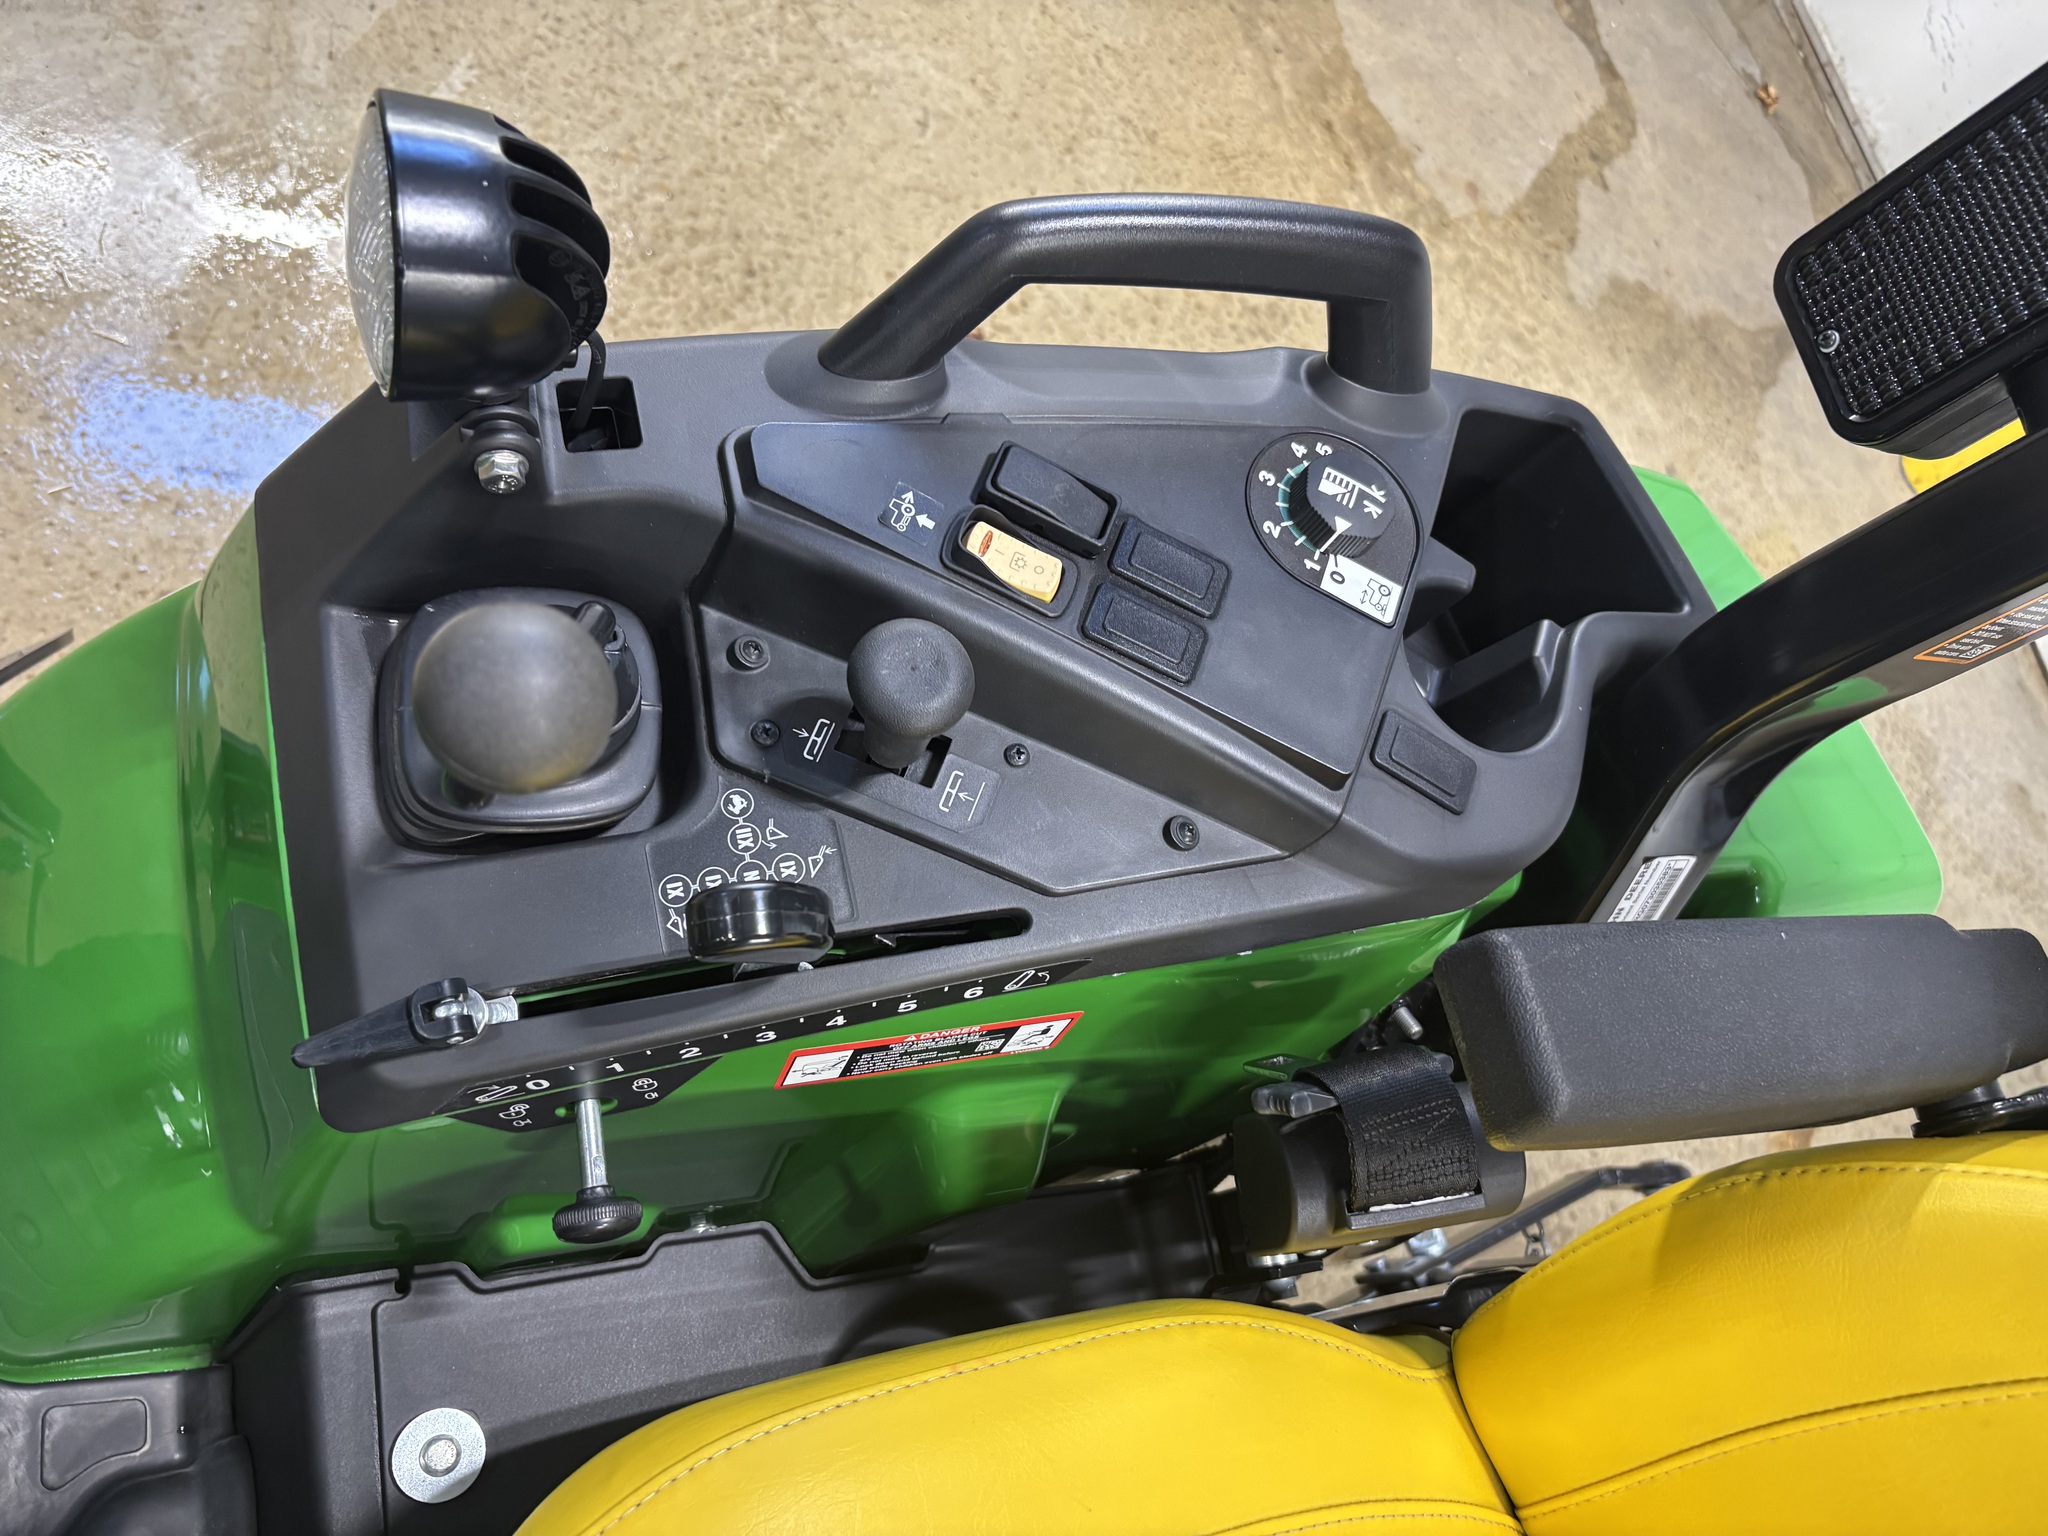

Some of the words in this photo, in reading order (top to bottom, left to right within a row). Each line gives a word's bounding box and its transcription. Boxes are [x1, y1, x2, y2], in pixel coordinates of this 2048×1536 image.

[1291, 441, 1308, 459] 4
[1315, 442, 1333, 456] 5
[1259, 471, 1276, 486] 3
[1264, 521, 1281, 539] 2
[1304, 558, 1321, 572] 1
[1330, 571, 1346, 585] 0
[1624, 862, 1652, 900] DEERE
[525, 1079, 550, 1090] 0
[606, 1062, 624, 1072] 1
[679, 1047, 702, 1059] 2
[758, 1030, 777, 1042] 3
[826, 1015, 847, 1026] 4
[897, 1000, 918, 1012] 5
[963, 986, 984, 999] 6
[920, 1026, 980, 1039] DANGER
[890, 1039, 932, 1048] ROTATING
